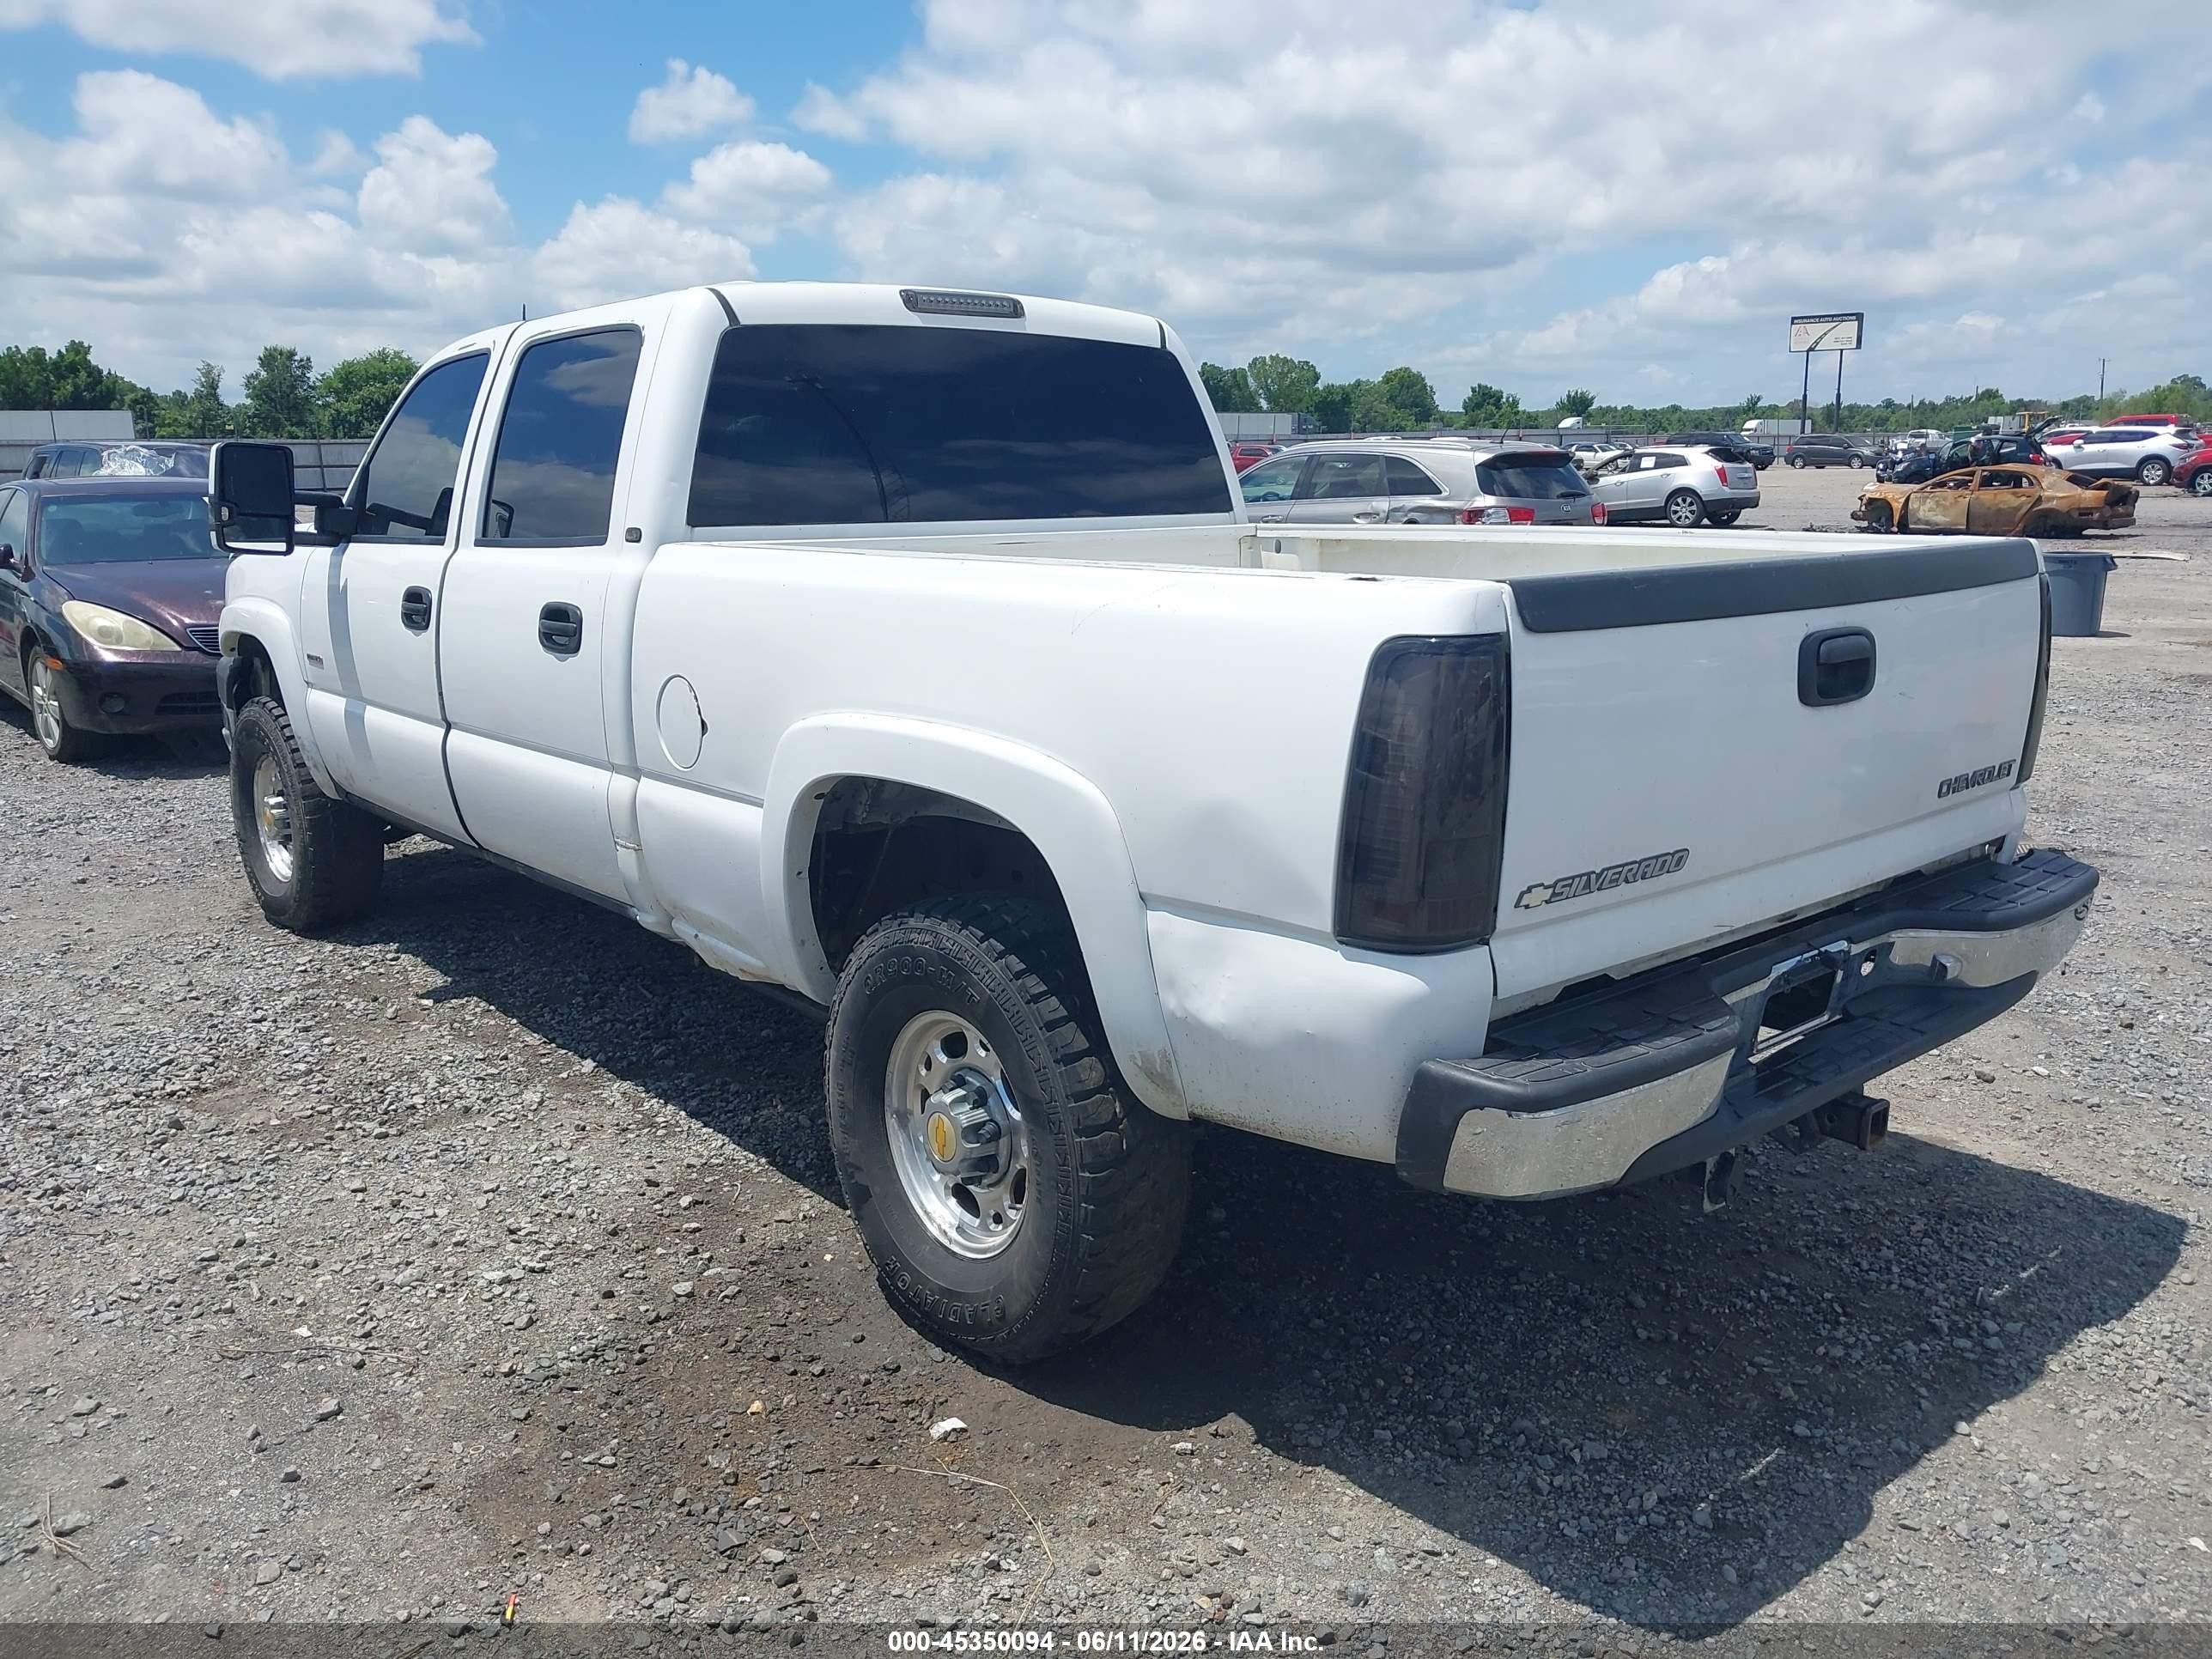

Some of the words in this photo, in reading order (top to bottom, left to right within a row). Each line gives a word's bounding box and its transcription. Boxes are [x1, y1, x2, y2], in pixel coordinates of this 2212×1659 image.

[1937, 759, 2016, 799] CHEVROLET
[1547, 848, 1690, 904] SILVERADO
[864, 956, 981, 1006] QR900-M/T
[884, 1255, 1005, 1325] GLADIATOR
